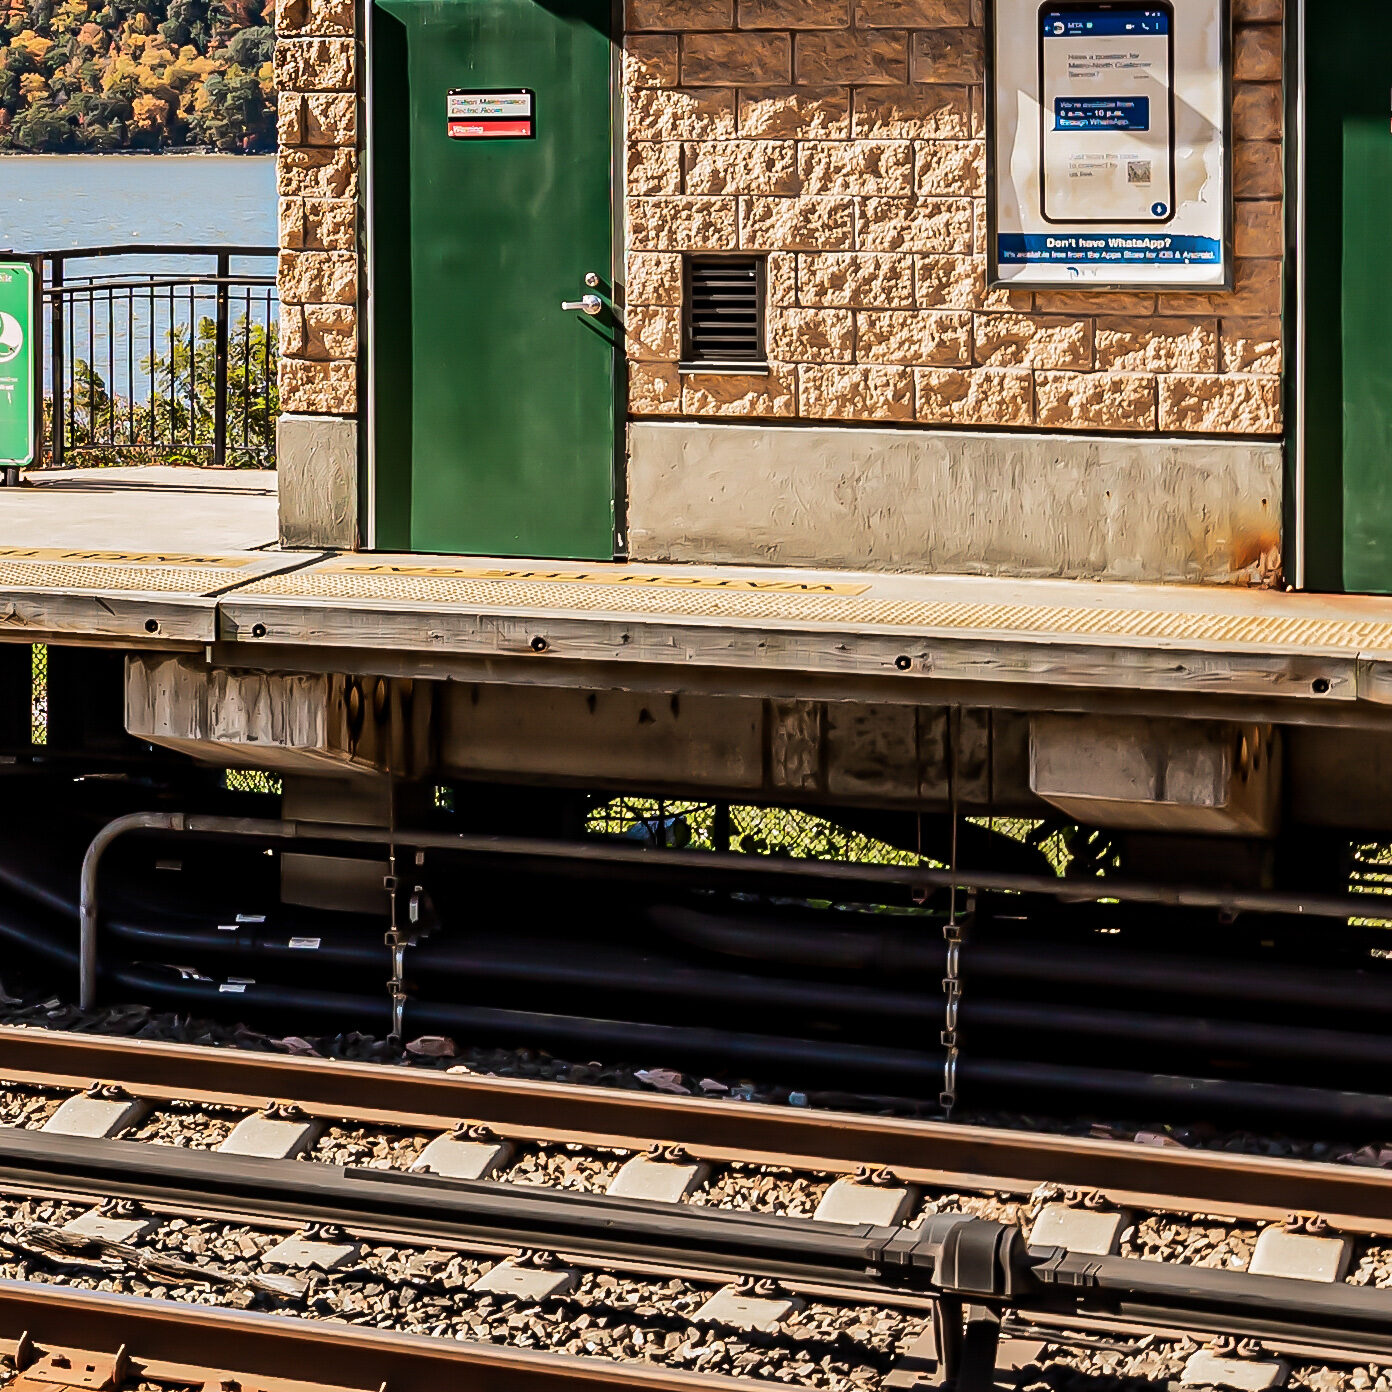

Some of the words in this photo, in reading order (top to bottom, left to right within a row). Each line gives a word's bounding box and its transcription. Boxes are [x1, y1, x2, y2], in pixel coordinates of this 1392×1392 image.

[1046, 238, 1076, 247] Don't
[1079, 238, 1106, 247] have
[1108, 238, 1172, 249] WhatsApp?
[60, 552, 224, 563] WATCH
[344, 565, 464, 574] GAP
[483, 569, 596, 581] THE
[618, 576, 834, 592] WATCH
